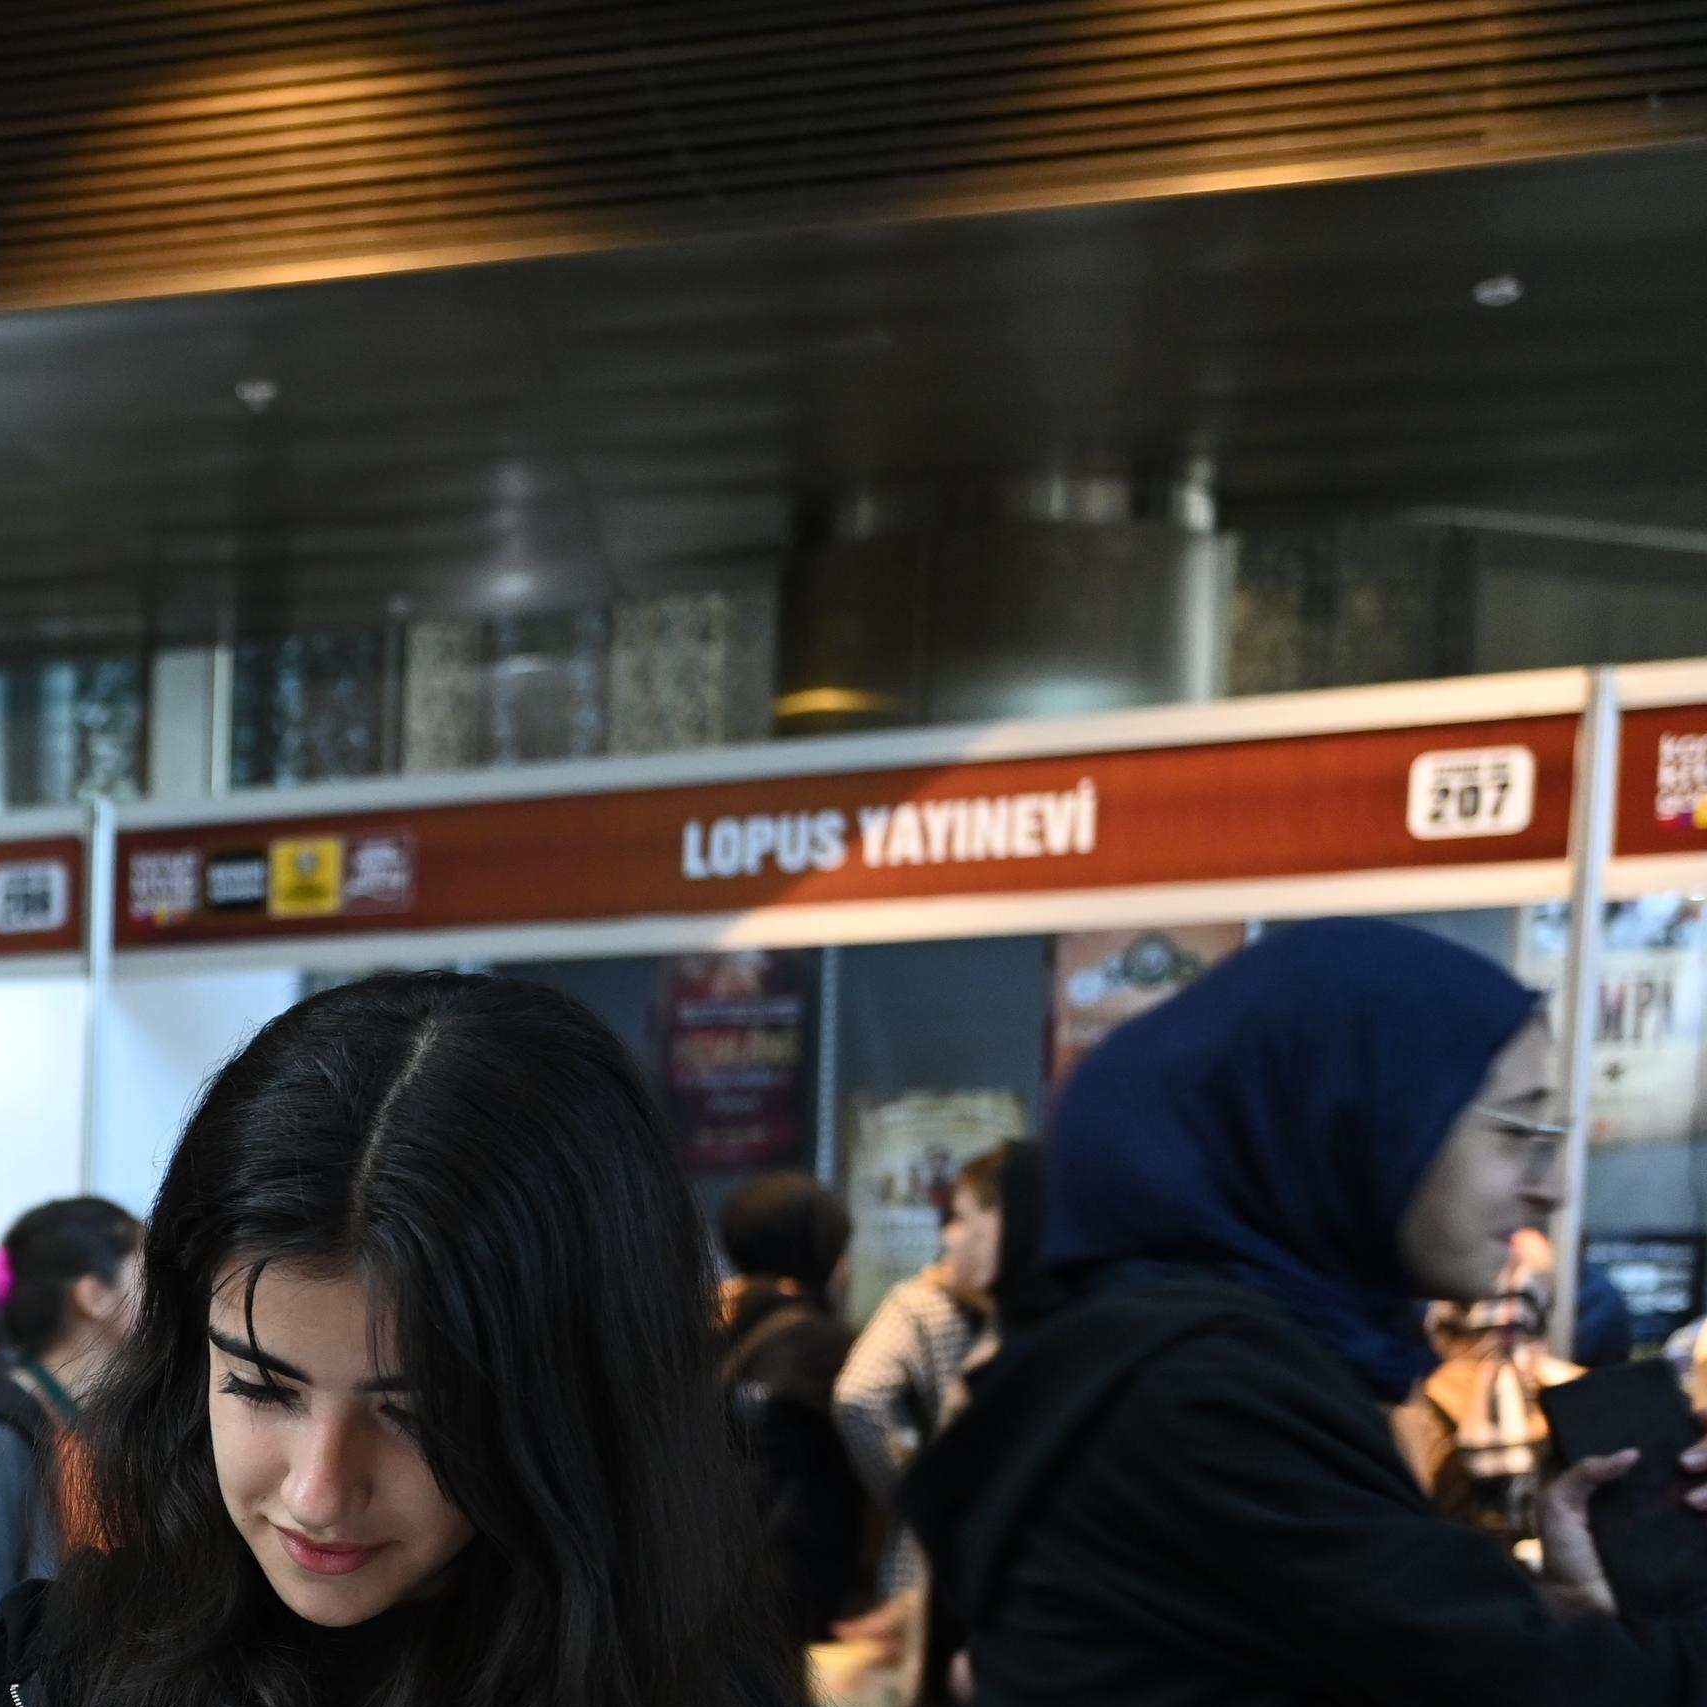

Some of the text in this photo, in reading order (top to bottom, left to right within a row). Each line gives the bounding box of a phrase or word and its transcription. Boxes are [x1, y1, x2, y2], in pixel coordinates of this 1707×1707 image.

[681, 777, 1097, 881] LOPUS YAYINEVİ
[1429, 784, 1510, 824] 207
